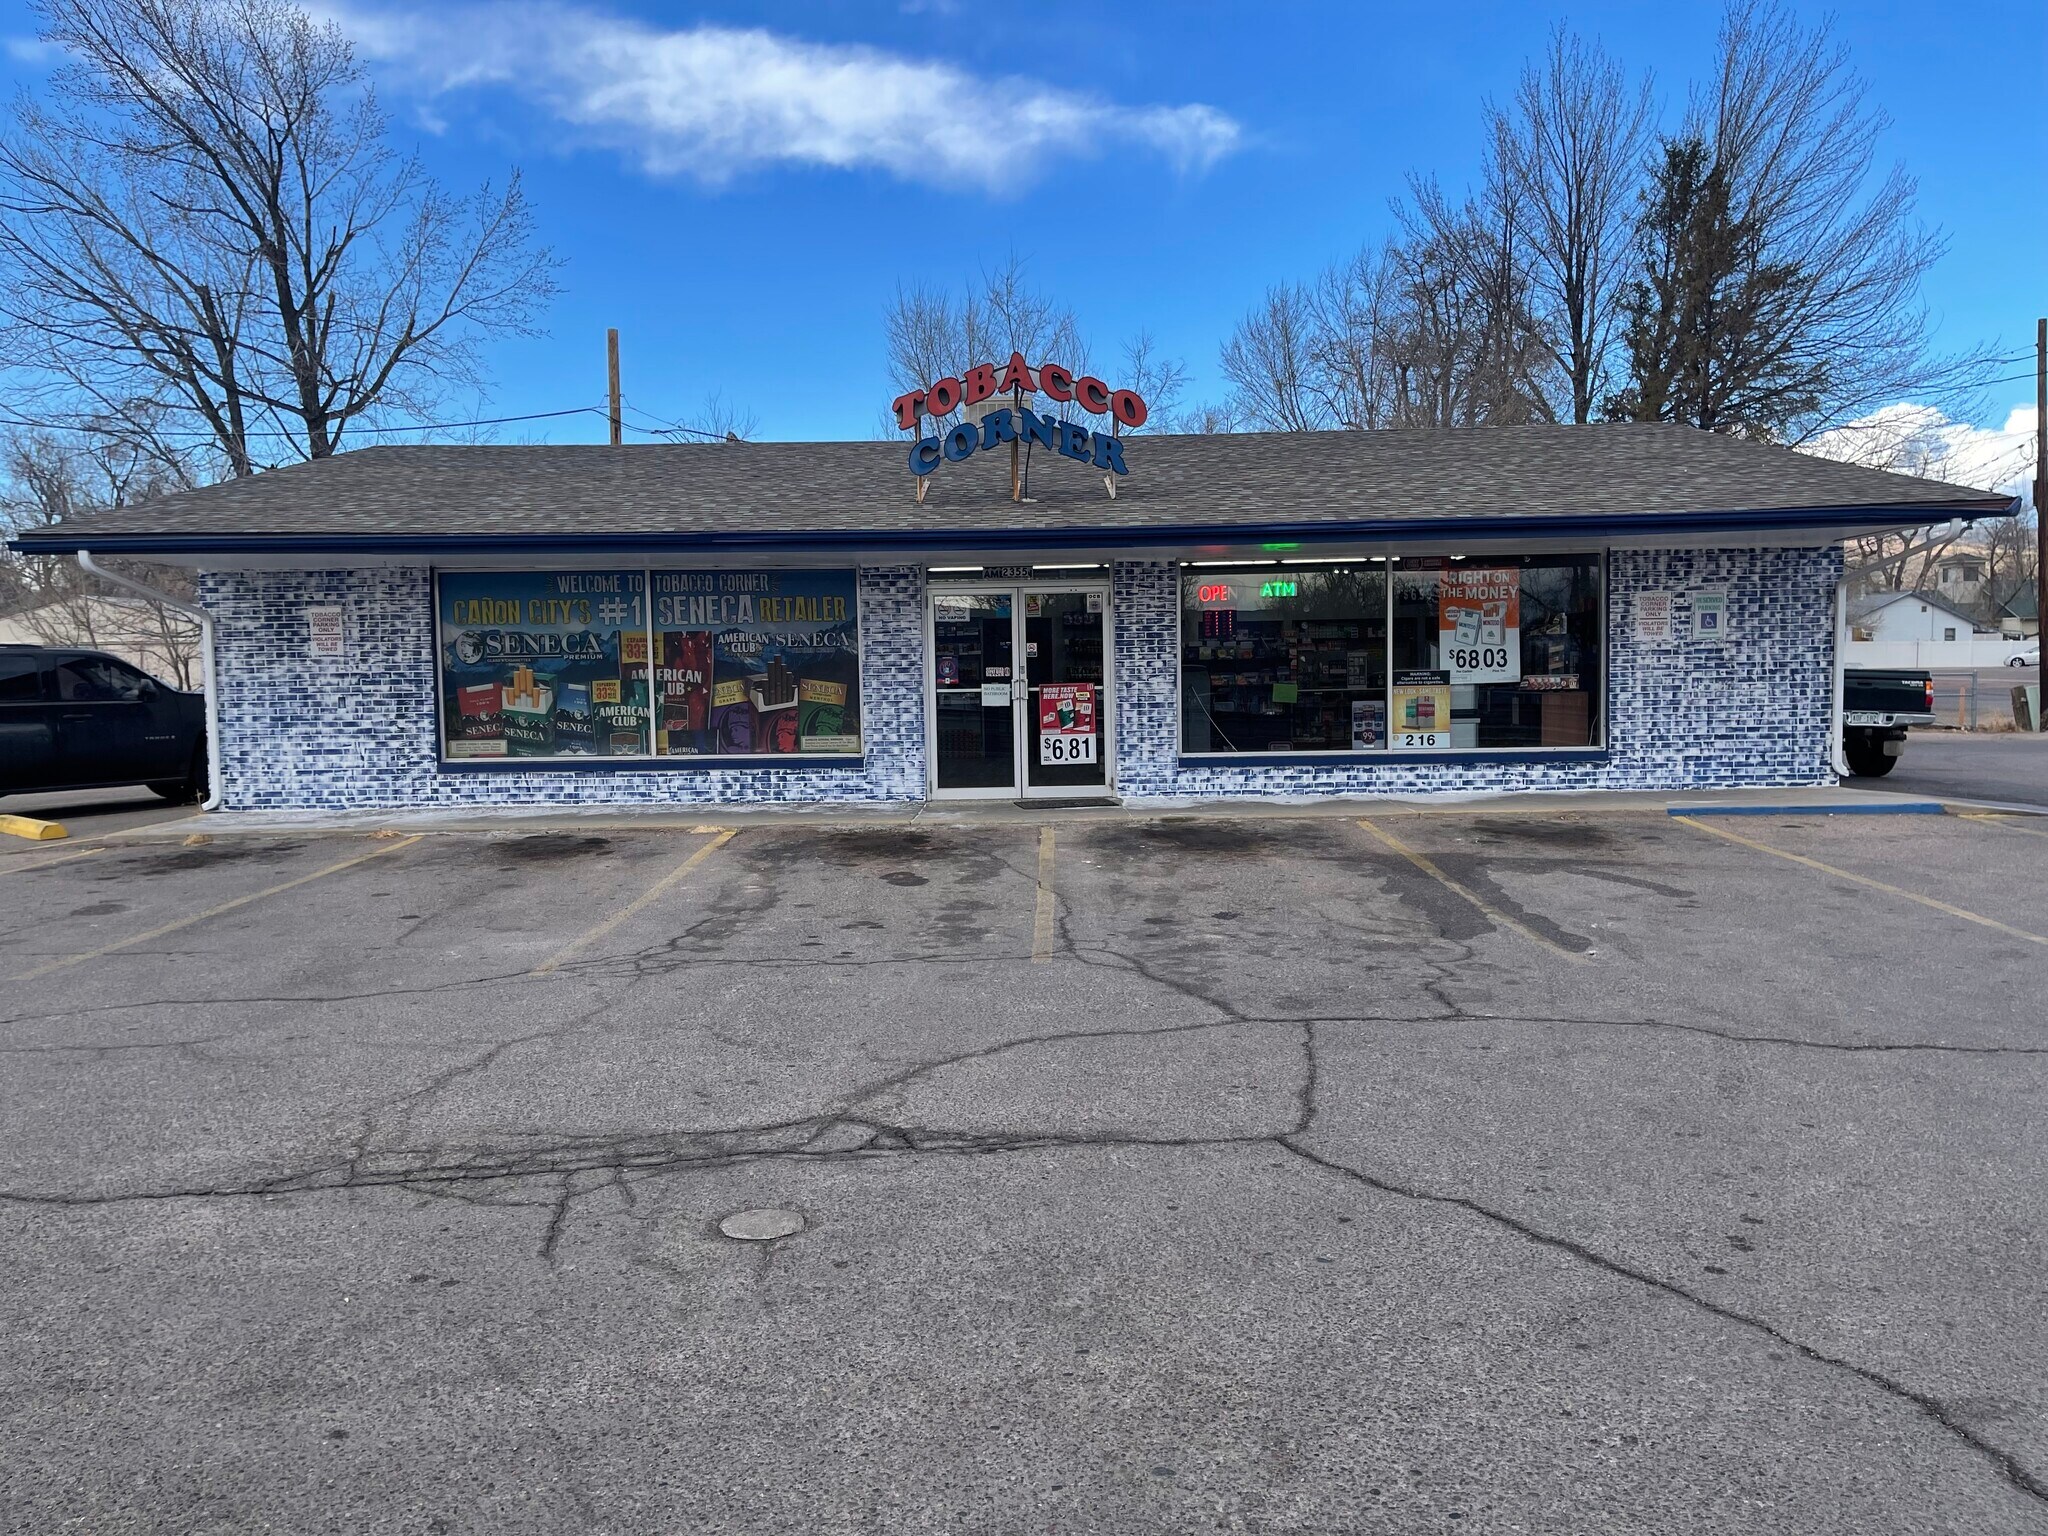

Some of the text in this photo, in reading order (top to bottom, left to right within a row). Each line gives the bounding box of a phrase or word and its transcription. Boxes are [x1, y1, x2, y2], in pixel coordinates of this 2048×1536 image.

[892, 351, 1148, 430] TOBACCO
[909, 408, 1130, 476] CORNER
[1003, 567, 1028, 577] 2355
[1448, 571, 1510, 585] RIGHT ON
[557, 574, 770, 593] WELCOME TO TOBACCO CORNER
[1260, 581, 1297, 598] ATM
[1198, 584, 1238, 602] OPEN
[1442, 585, 1519, 600] THE MONEY
[1696, 596, 1723, 604] RESERVED
[453, 595, 846, 626] CAÑON CITY'S #1 SENECA RETAILER
[486, 632, 602, 655] SENECA
[717, 632, 769, 645] AMERICAN
[775, 632, 849, 647] SENECA
[731, 643, 756, 653] CLUB
[1449, 648, 1508, 670] $68.03
[599, 706, 650, 718] AMERICAN
[556, 721, 592, 733] SENEC
[612, 716, 637, 726] CLUB
[466, 723, 503, 736] SENEC
[504, 728, 545, 741] SENECA
[671, 746, 699, 754] AMERICAN
[1044, 737, 1090, 761] $6.81
